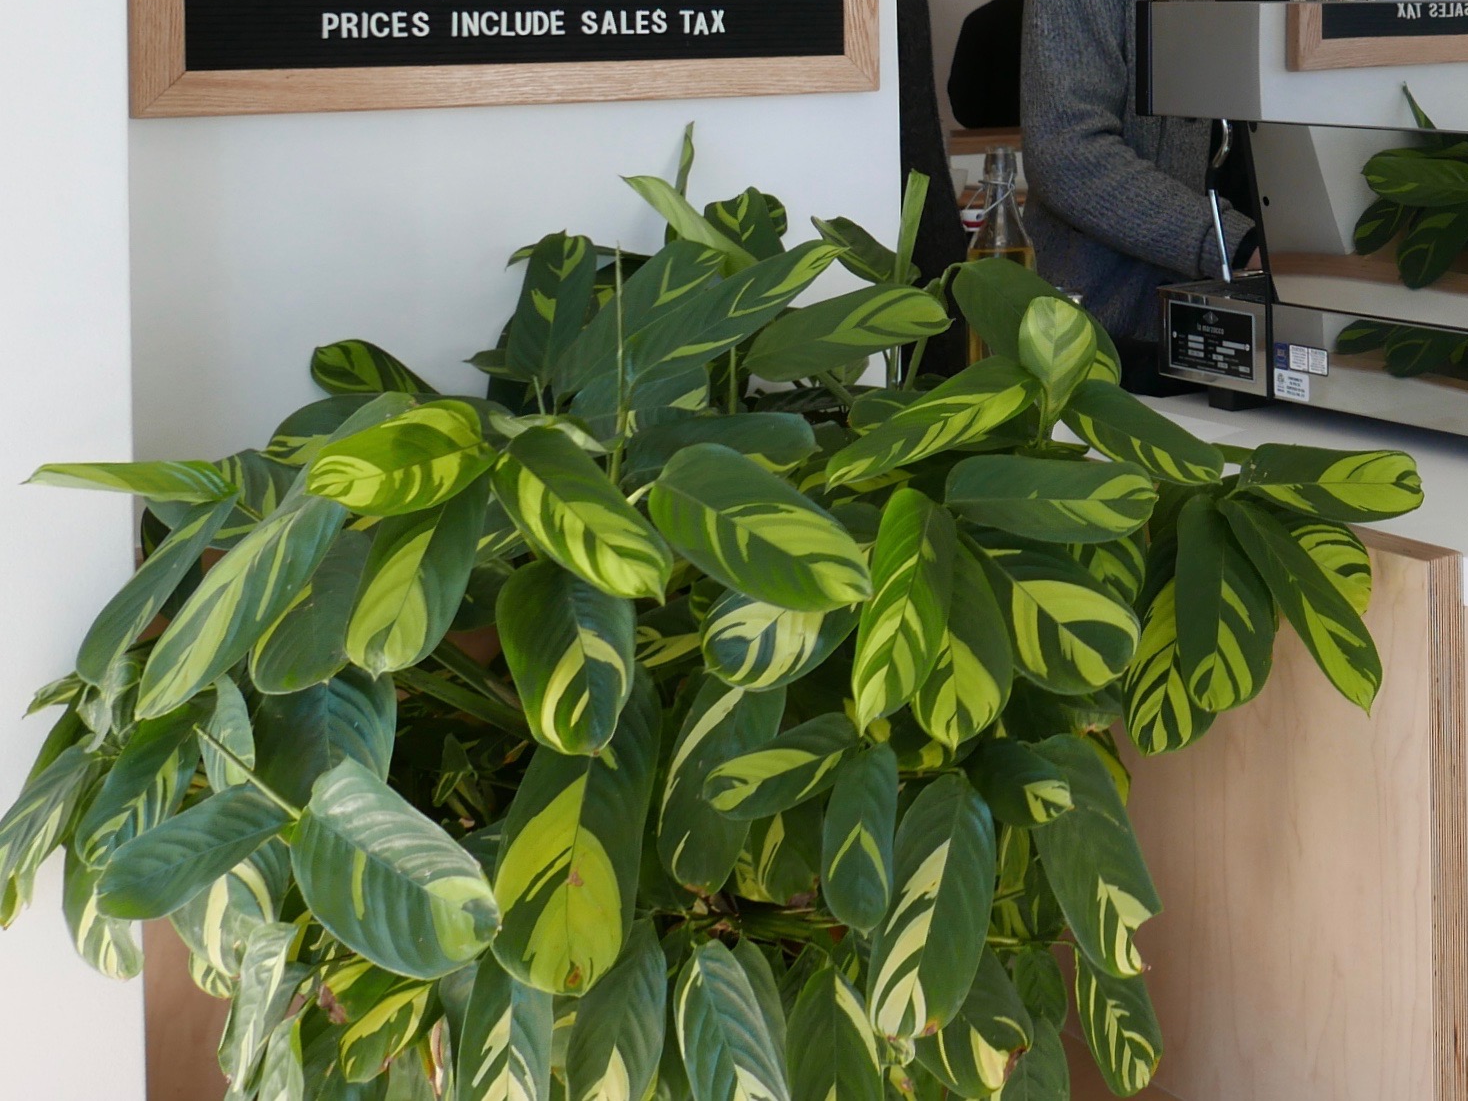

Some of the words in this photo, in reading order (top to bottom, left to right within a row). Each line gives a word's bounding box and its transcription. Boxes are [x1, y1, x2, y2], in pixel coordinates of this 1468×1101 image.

[321, 10, 430, 39] PRICES
[451, 9, 566, 38] INCLUDE
[581, 8, 668, 35] SALES
[678, 9, 726, 36] TAX
